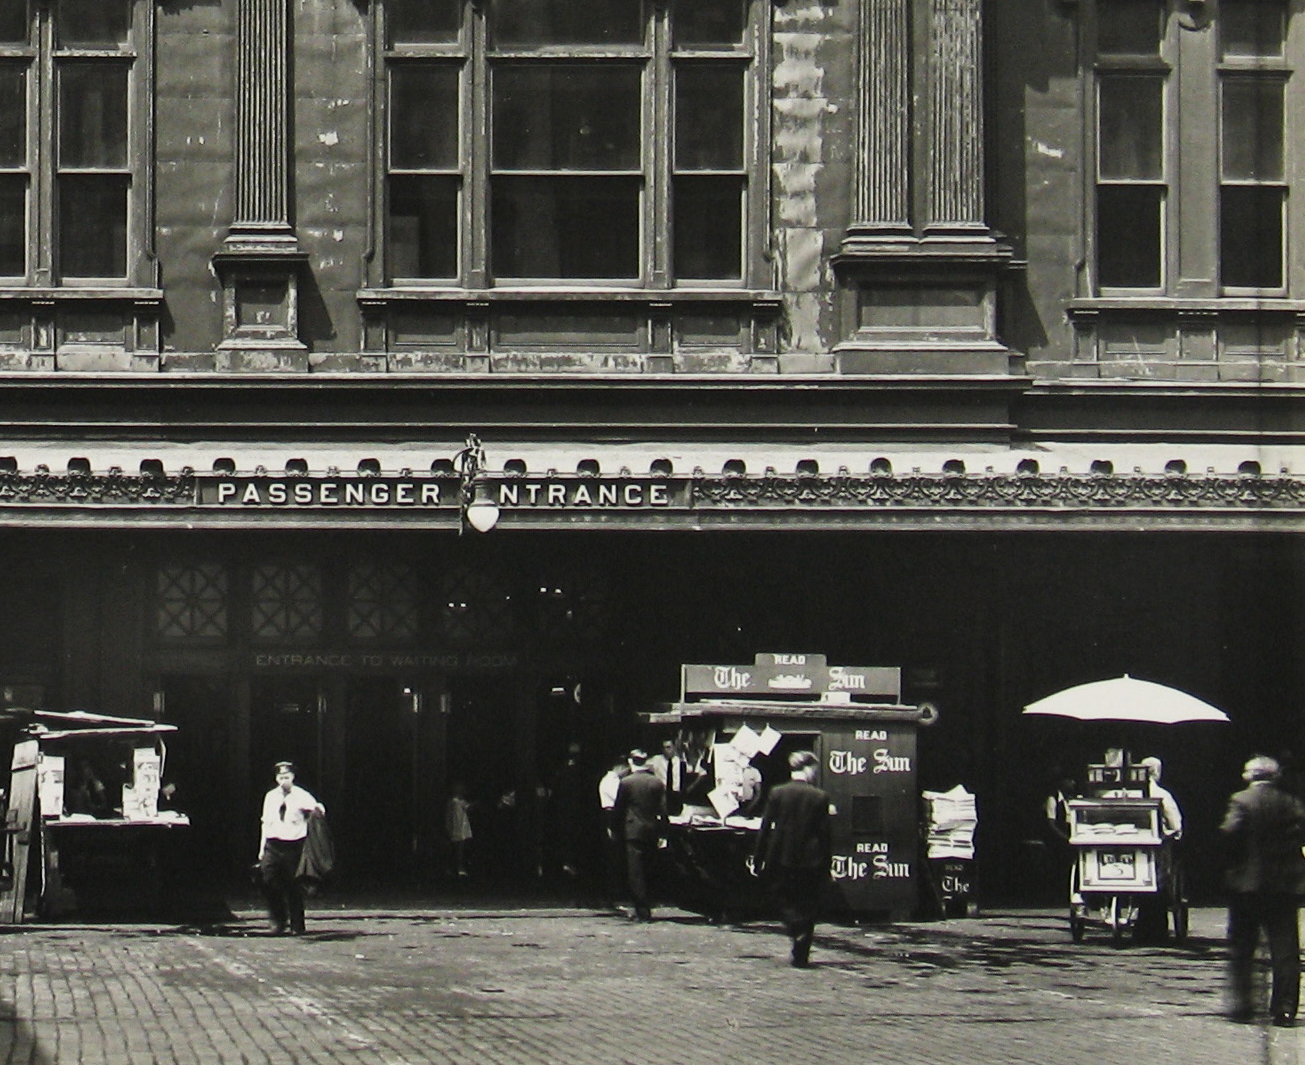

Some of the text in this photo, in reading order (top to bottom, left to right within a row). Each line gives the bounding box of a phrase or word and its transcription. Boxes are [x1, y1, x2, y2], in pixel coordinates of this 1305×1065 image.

[217, 483, 669, 505] PASSENGER NTRANCE
[255, 654, 352, 667] ENTRANCE
[362, 654, 382, 667] TO
[774, 654, 806, 665] READ
[714, 666, 866, 690] The Sun
[855, 730, 887, 741] READ
[829, 748, 911, 776] The Sun
[856, 843, 889, 854] READ
[830, 855, 910, 881] The Sun
[942, 875, 970, 894] The
